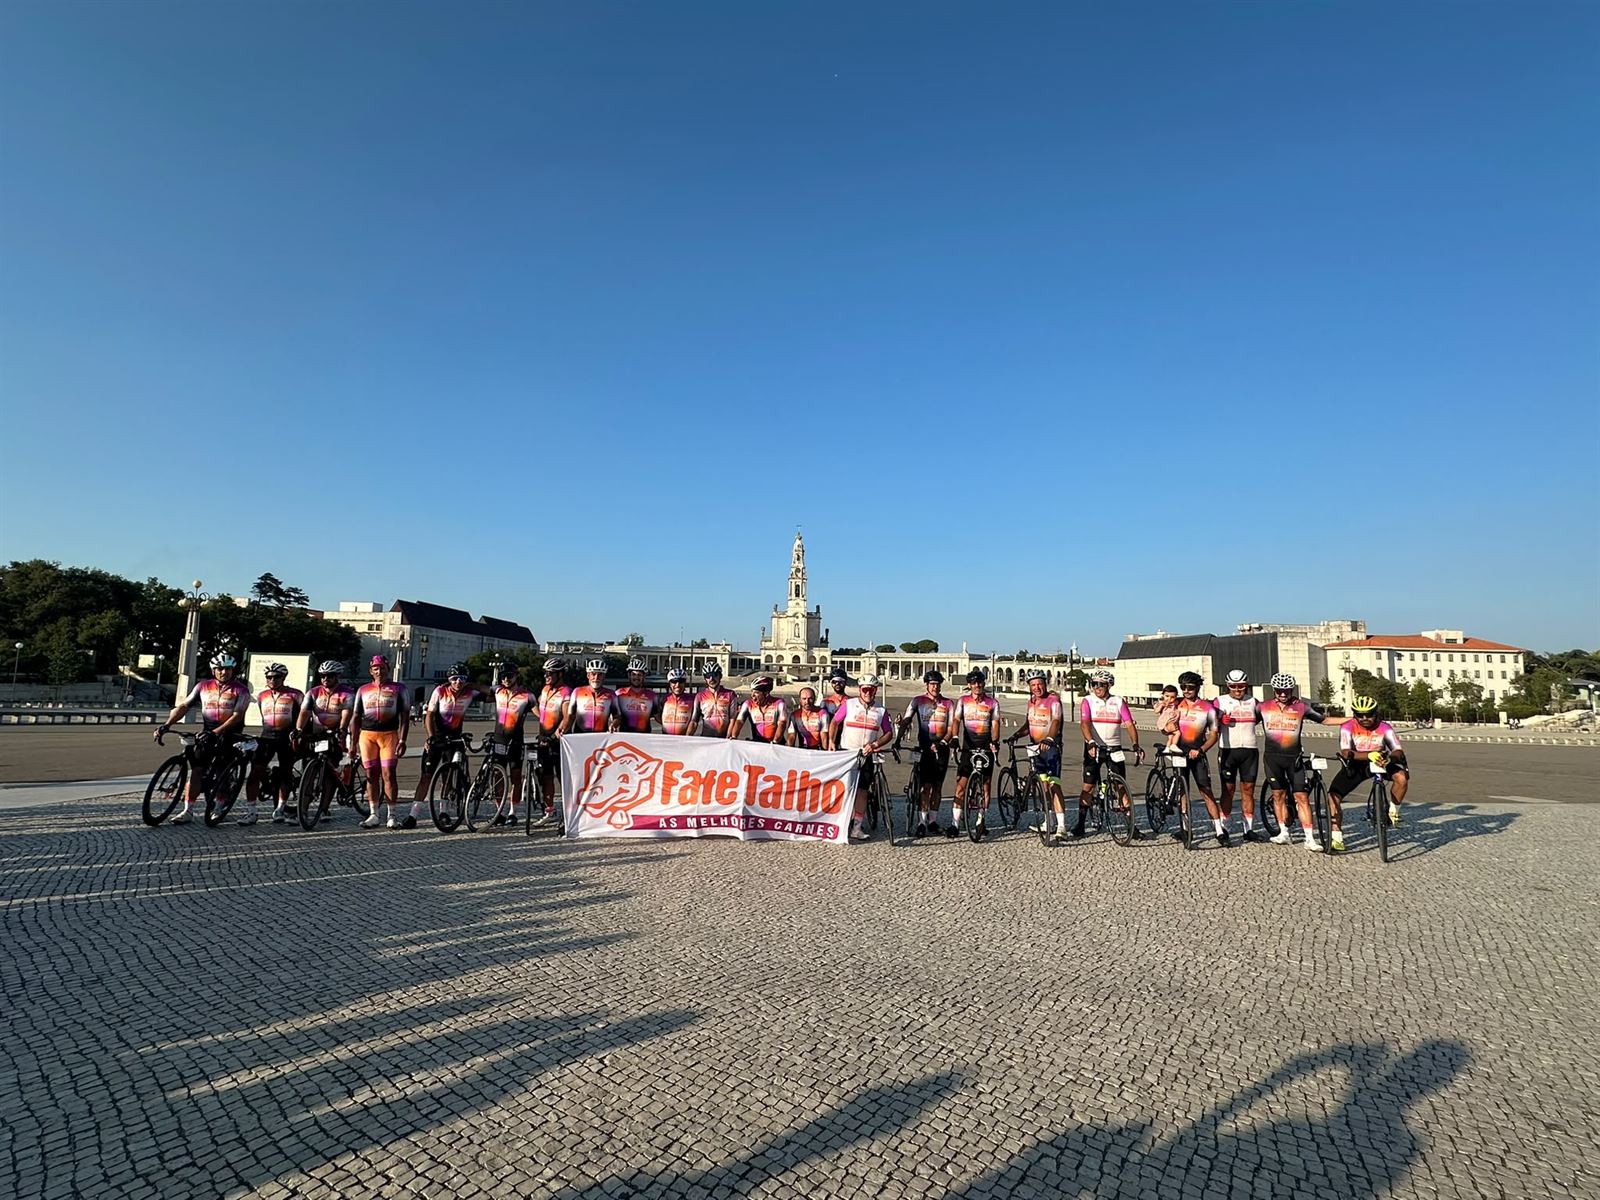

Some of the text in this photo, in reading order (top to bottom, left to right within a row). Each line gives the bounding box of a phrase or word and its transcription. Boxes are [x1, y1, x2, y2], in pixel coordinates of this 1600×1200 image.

[743, 764, 846, 815] Talho
[659, 816, 836, 838] AS MELHORES CARNES
